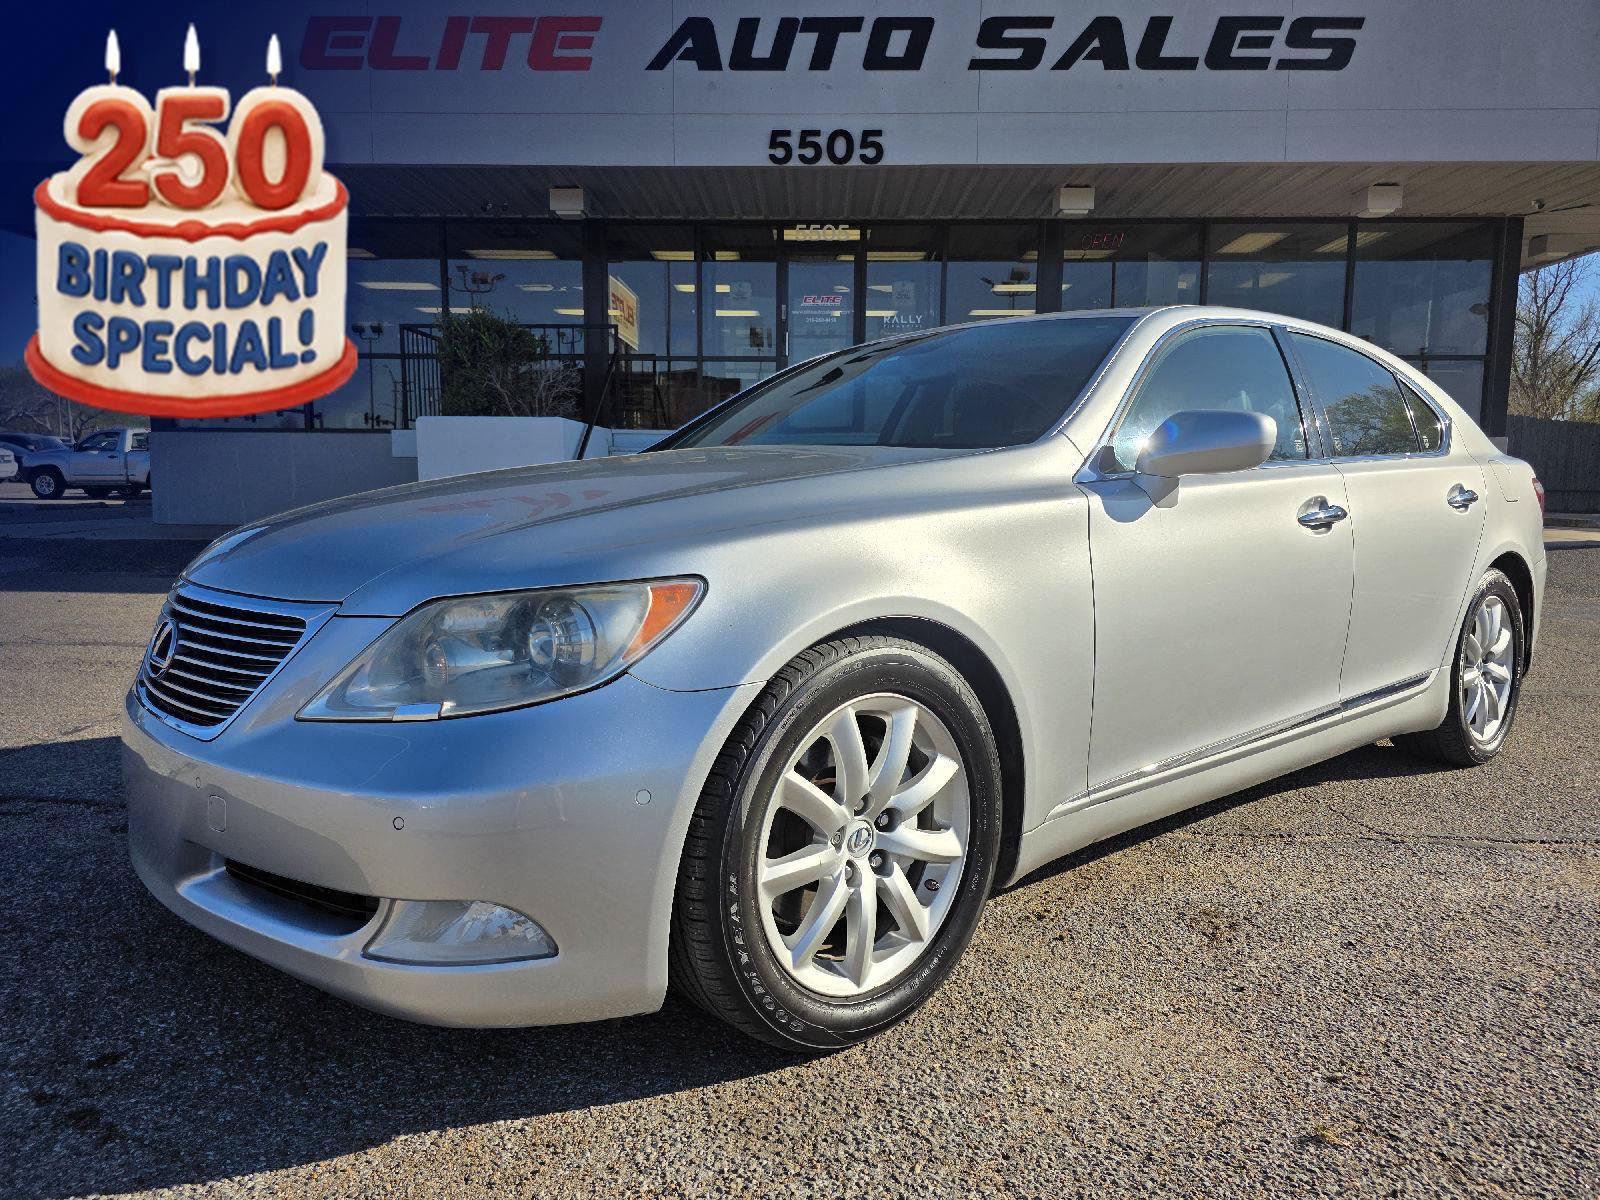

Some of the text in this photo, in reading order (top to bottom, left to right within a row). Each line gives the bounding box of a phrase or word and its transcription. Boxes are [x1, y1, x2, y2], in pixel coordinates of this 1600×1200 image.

[300, 16, 1366, 71] ELITE AUTO SALES
[768, 129, 884, 165] 5505
[795, 225, 850, 241] 5505
[802, 295, 842, 304] ELITE
[883, 314, 922, 324] RALLY
